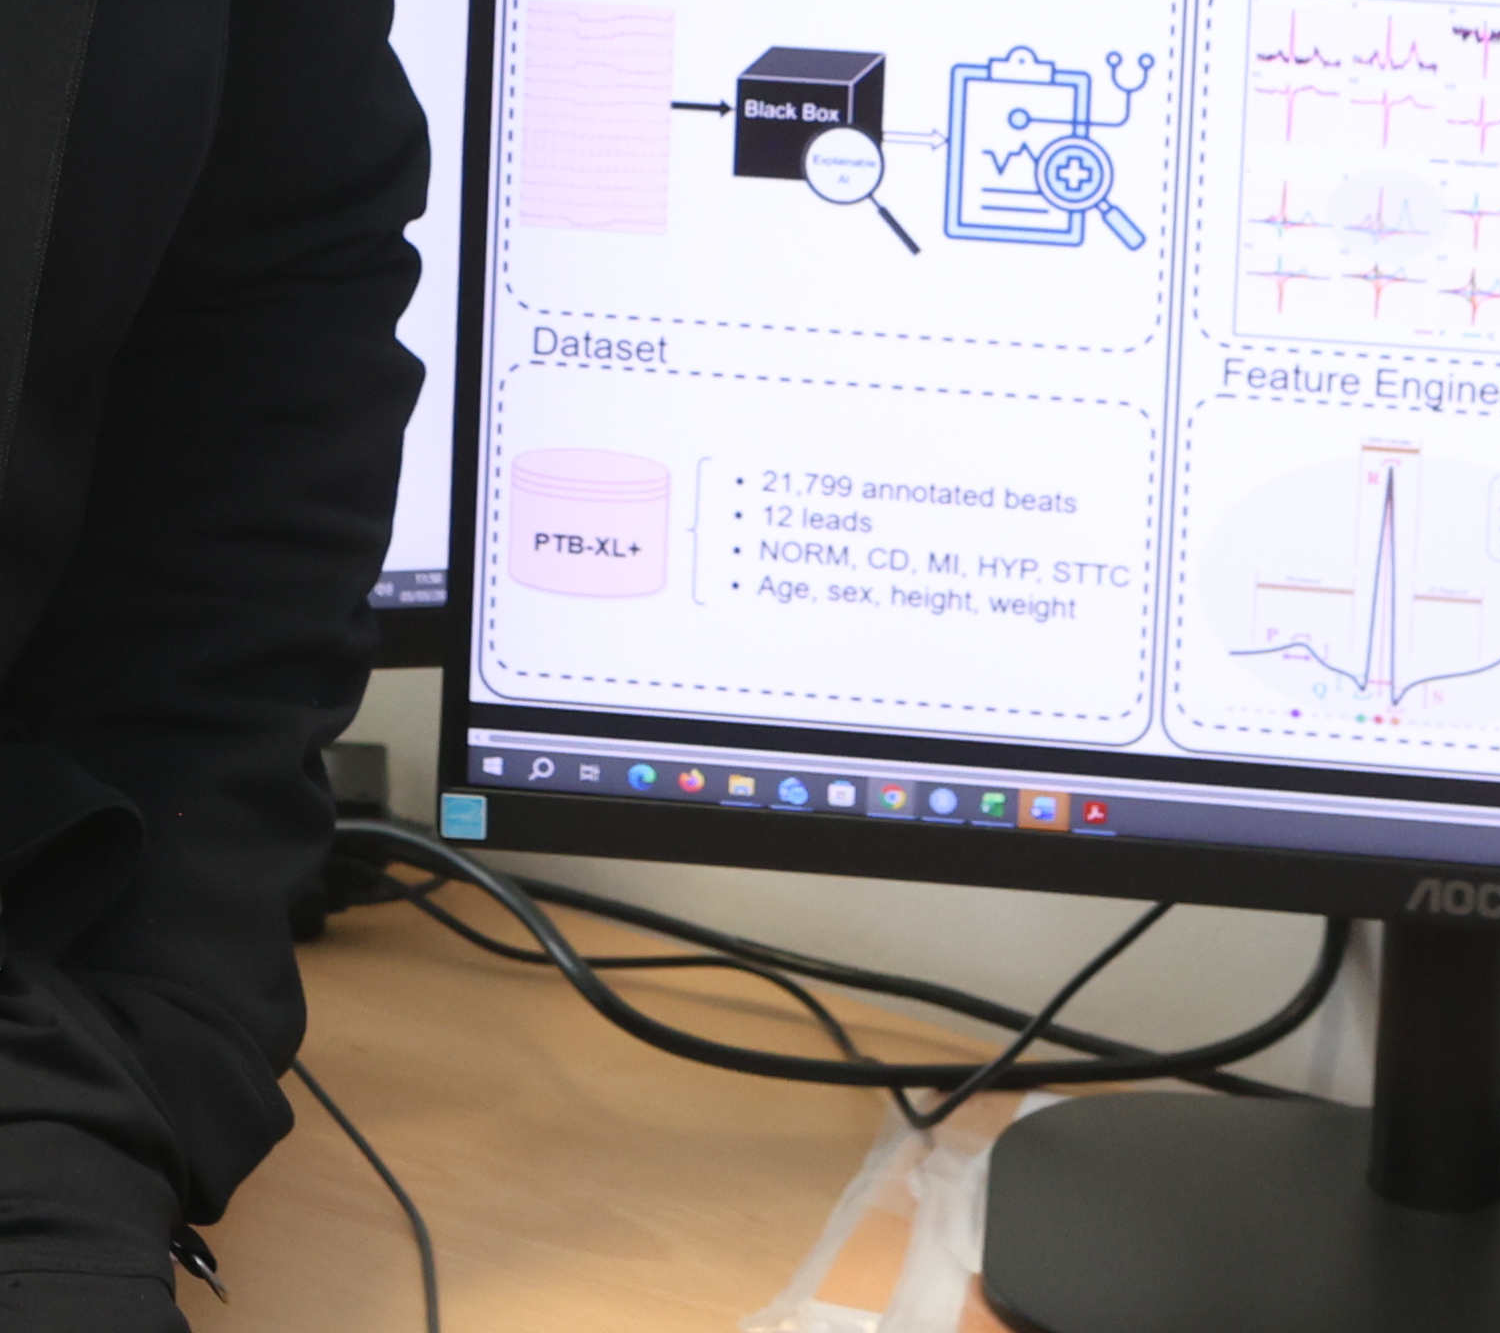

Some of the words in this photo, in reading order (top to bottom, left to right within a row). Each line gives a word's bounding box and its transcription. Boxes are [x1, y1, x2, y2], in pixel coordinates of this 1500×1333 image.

[743, 98, 798, 120] Black
[801, 102, 840, 123] Box
[529, 325, 667, 365] Dataset
[1220, 355, 1363, 397] Feature
[761, 469, 854, 498] 21,799
[860, 481, 995, 509] annotated
[1003, 487, 1077, 515] beats
[764, 504, 793, 528] 12
[802, 507, 873, 534] leads
[534, 532, 641, 558] PTB-XL+
[759, 539, 856, 569] NORM,
[866, 546, 917, 574] CD,
[927, 550, 967, 579] MI,
[978, 555, 1041, 583] HYP,
[1052, 560, 1130, 589] STTC
[757, 574, 816, 605] Age,
[827, 584, 879, 606] sex,
[890, 584, 978, 616] height,
[989, 597, 1076, 624] weight
